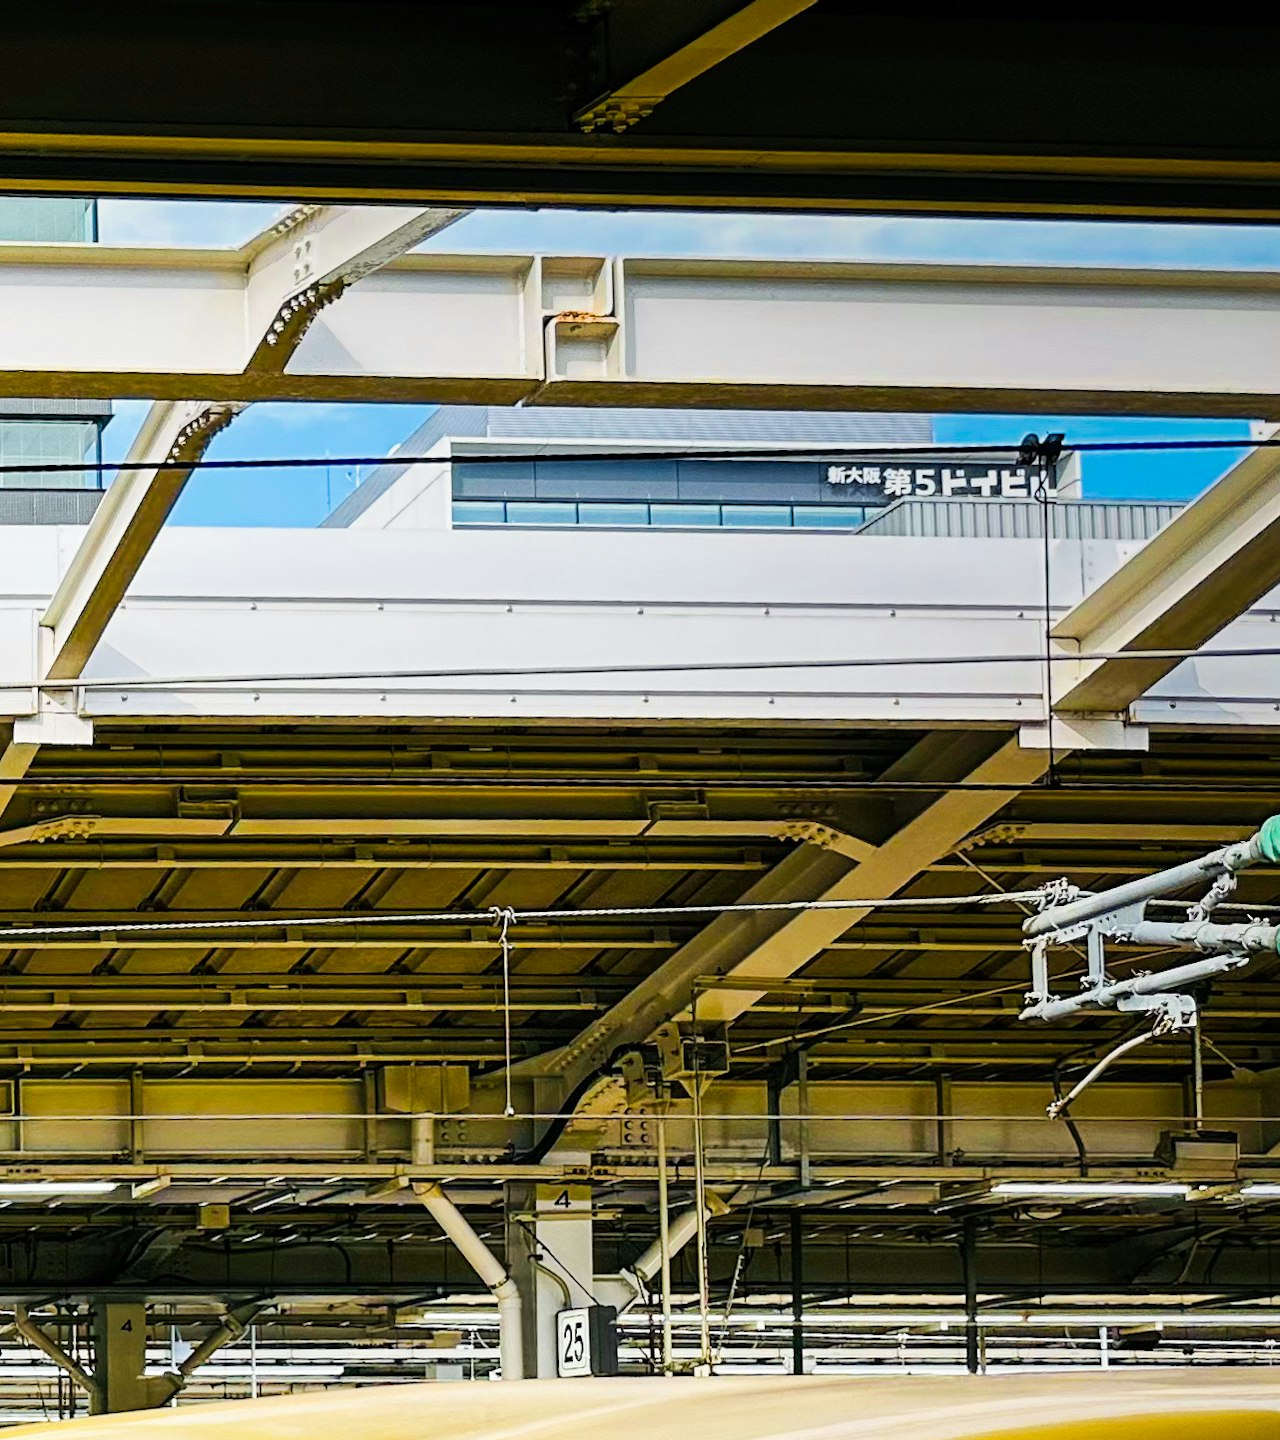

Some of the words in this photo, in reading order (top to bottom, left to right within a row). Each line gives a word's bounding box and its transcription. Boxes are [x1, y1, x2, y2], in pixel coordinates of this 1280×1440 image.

[828, 466, 881, 485] 新大阪
[554, 1190, 571, 1208] 4
[120, 1319, 132, 1332] 4
[564, 1322, 584, 1363] 25
